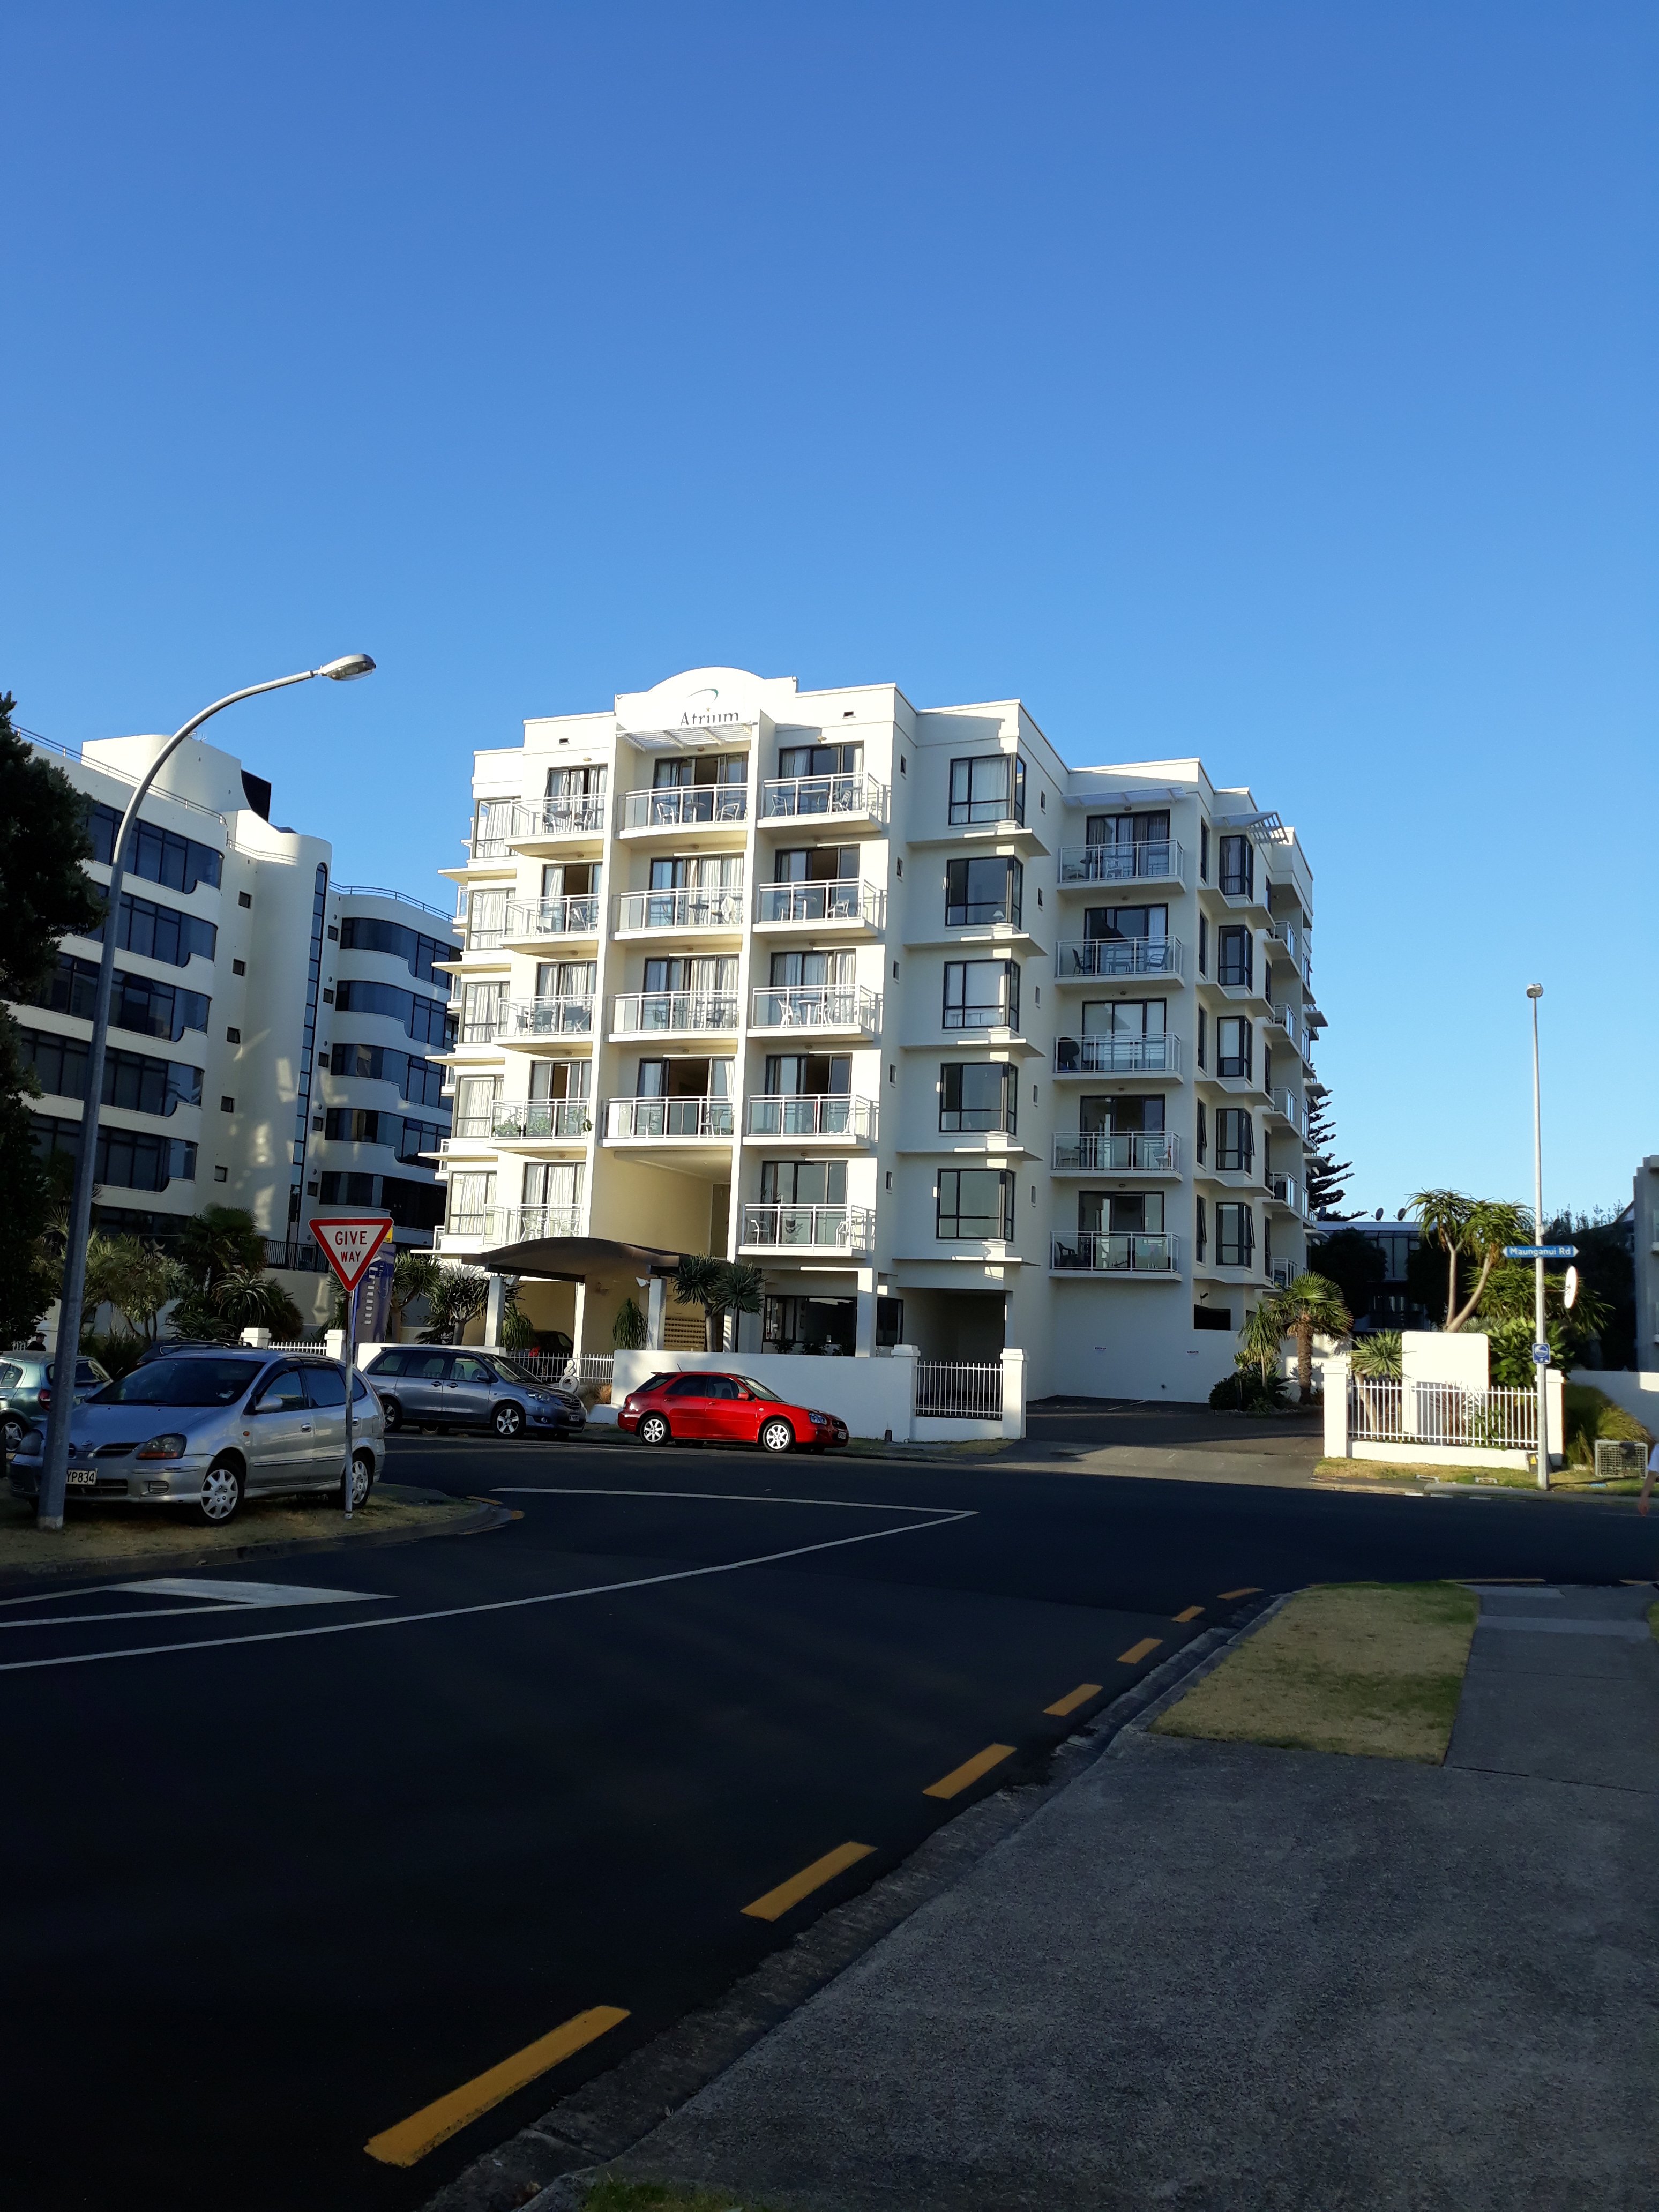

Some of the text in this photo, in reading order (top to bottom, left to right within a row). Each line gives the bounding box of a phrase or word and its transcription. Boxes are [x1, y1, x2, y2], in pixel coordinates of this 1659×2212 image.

[680, 709, 739, 726] Atrium
[335, 1231, 367, 1245] GIVE
[341, 1251, 361, 1262] WAY
[1510, 1247, 1556, 1256] Maunganui
[66, 1471, 95, 1483] YP834
